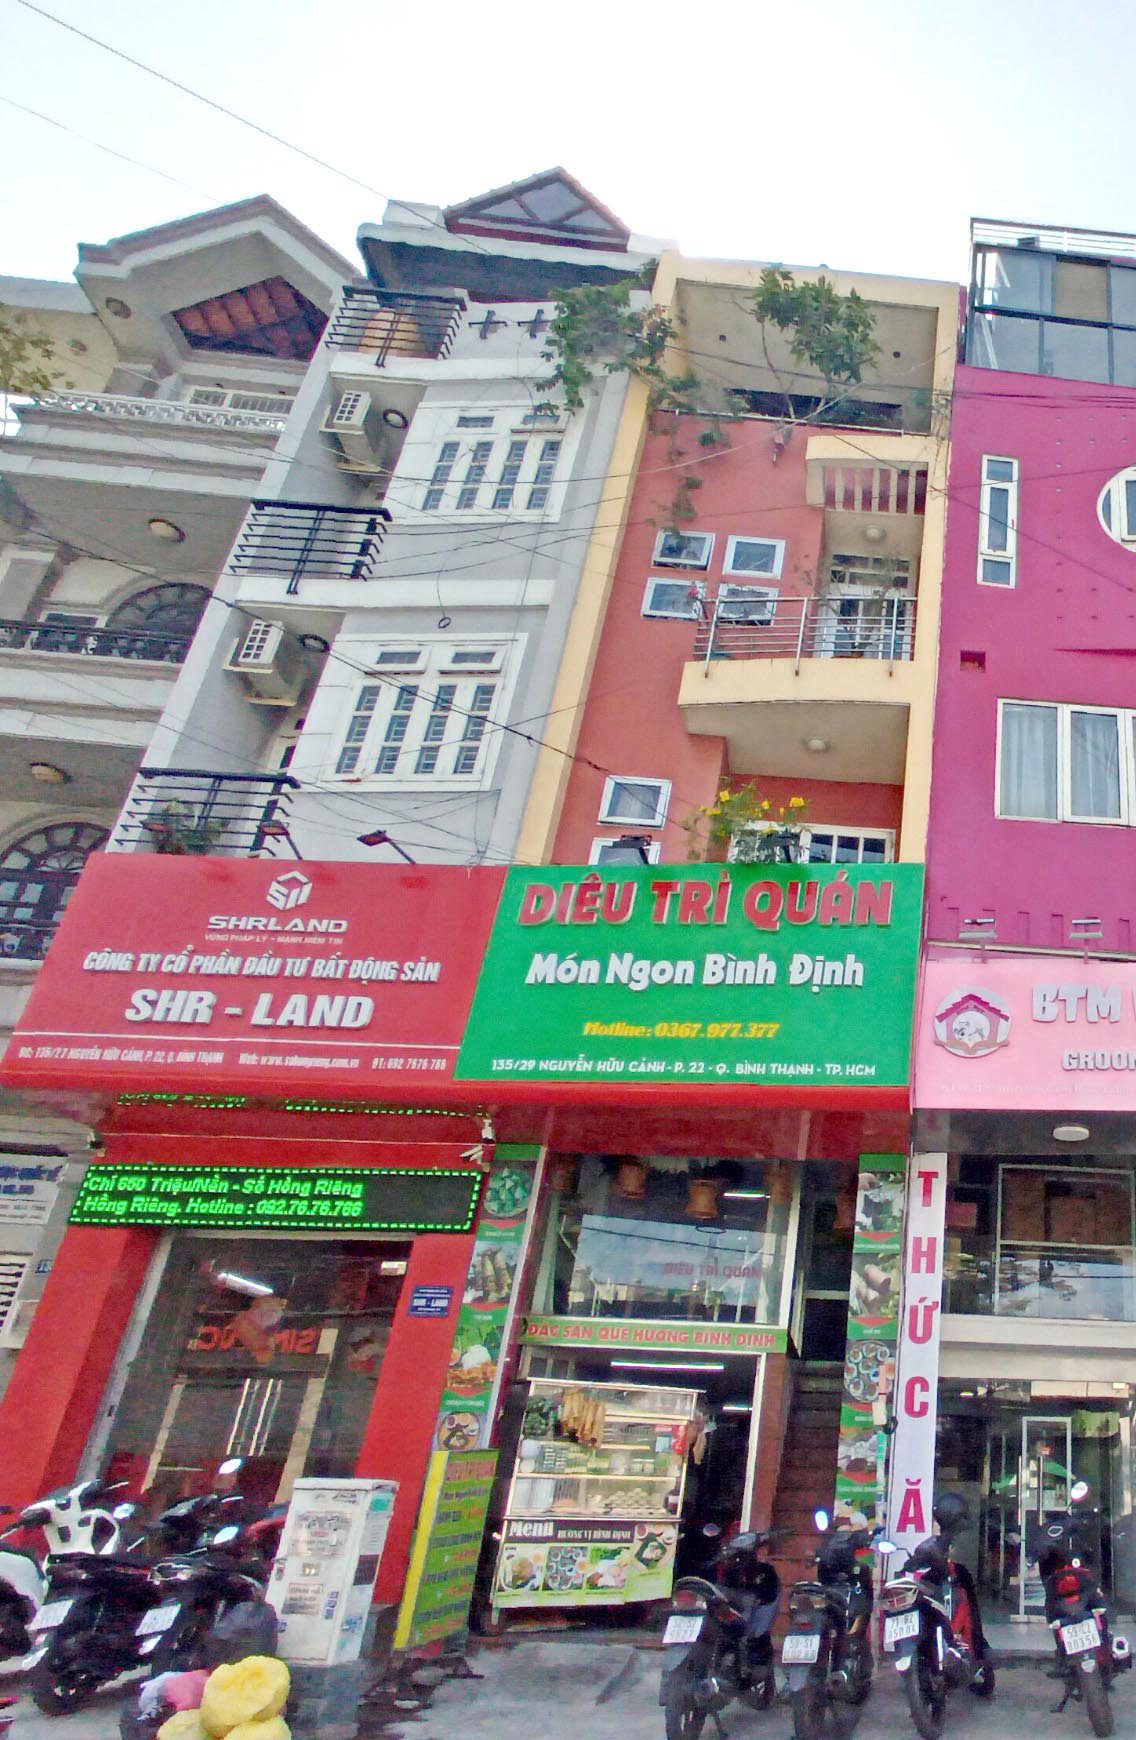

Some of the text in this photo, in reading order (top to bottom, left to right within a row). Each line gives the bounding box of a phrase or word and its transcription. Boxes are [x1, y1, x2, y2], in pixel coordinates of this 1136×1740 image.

[518, 873, 637, 926] DIÊU
[744, 870, 893, 931] QUÁN
[207, 915, 348, 933] SHRLAND
[83, 944, 441, 985] CÔNG TY CỔ PHẦN ĐẦU TƯ BẤT ĐỘNG SẢN
[525, 952, 865, 993] Món Ngon Bình Định
[125, 988, 374, 1029] SHR LAND
[1032, 983, 1122, 1024] BTM
[654, 1021, 780, 1038] 0367.977.377
[492, 1059, 536, 1071] 135/29
[539, 1052, 593, 1072] NGUYỄN
[597, 1057, 624, 1072] HỮU
[628, 1056, 665, 1073] CẢNH
[689, 1062, 704, 1074] 22
[735, 1059, 766, 1075] BÌNH
[770, 1063, 814, 1078] THẠNH
[845, 1064, 876, 1077] HCM
[83, 1193, 128, 1215] Hồng
[185, 1196, 244, 1215] Hotline
[118, 1176, 147, 1192] 650
[267, 1176, 312, 1198] Hồng
[314, 1178, 365, 1199] Riêng
[904, 1170, 940, 1418] THỨC
[509, 1520, 555, 1537] Menu
